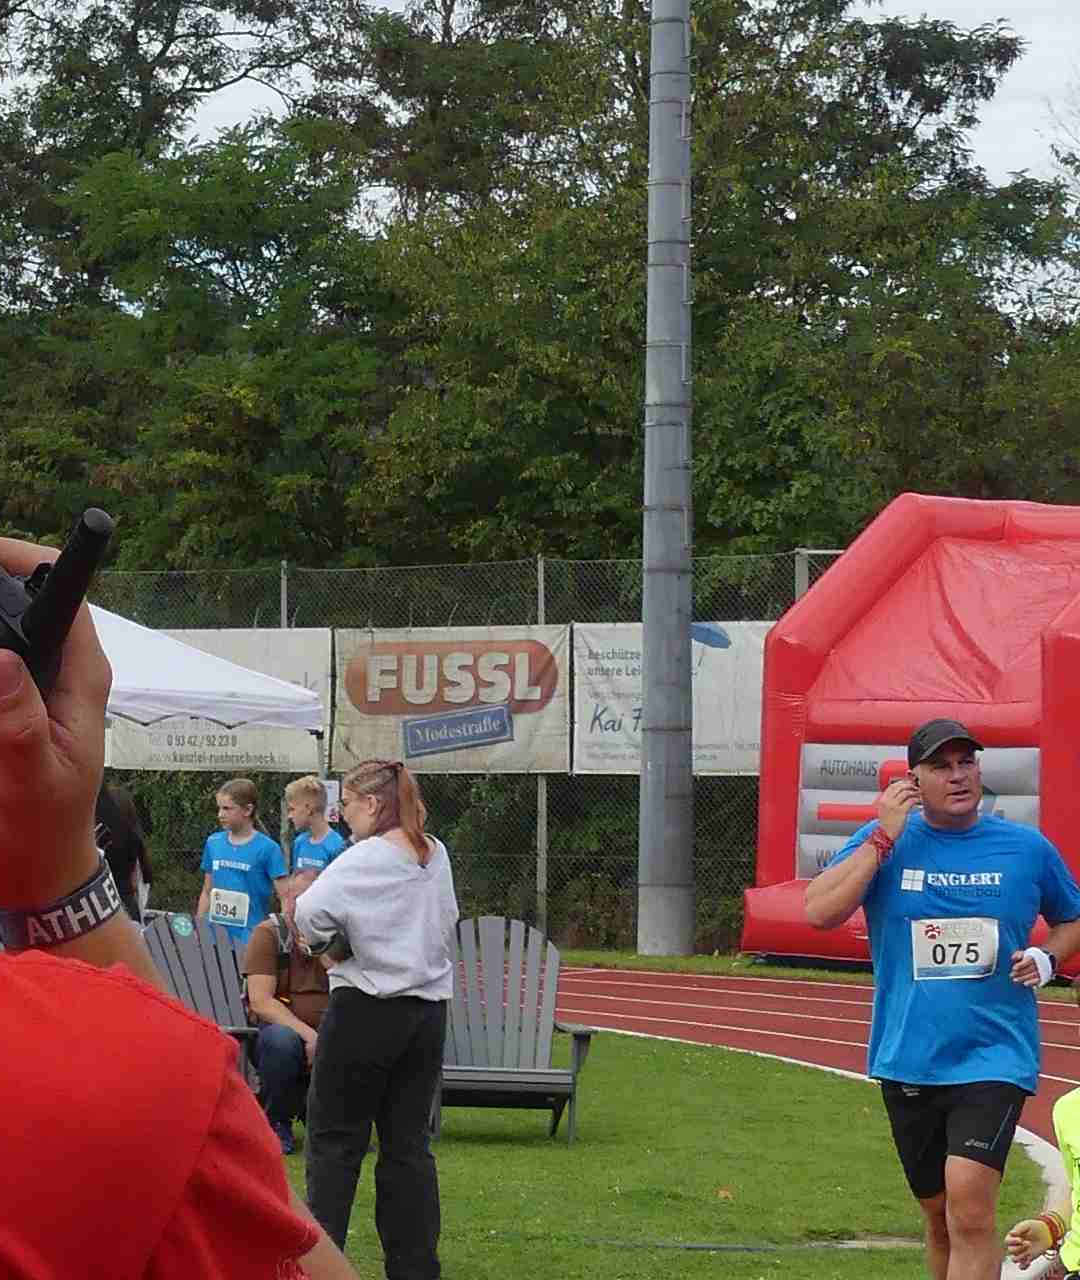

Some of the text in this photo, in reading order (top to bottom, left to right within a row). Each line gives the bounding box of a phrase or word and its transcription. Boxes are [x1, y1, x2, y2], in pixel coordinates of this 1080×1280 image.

[588, 647, 642, 661] Beschütze
[367, 651, 542, 704] FUSSL
[625, 664, 642, 677] Lei
[590, 703, 625, 734] Kai
[416, 716, 503, 745] Modestraße
[820, 759, 879, 777] AUTOHAUS
[927, 872, 1002, 886] ENGLERT
[26, 873, 121, 945] ATHLE
[932, 942, 980, 965] 075
